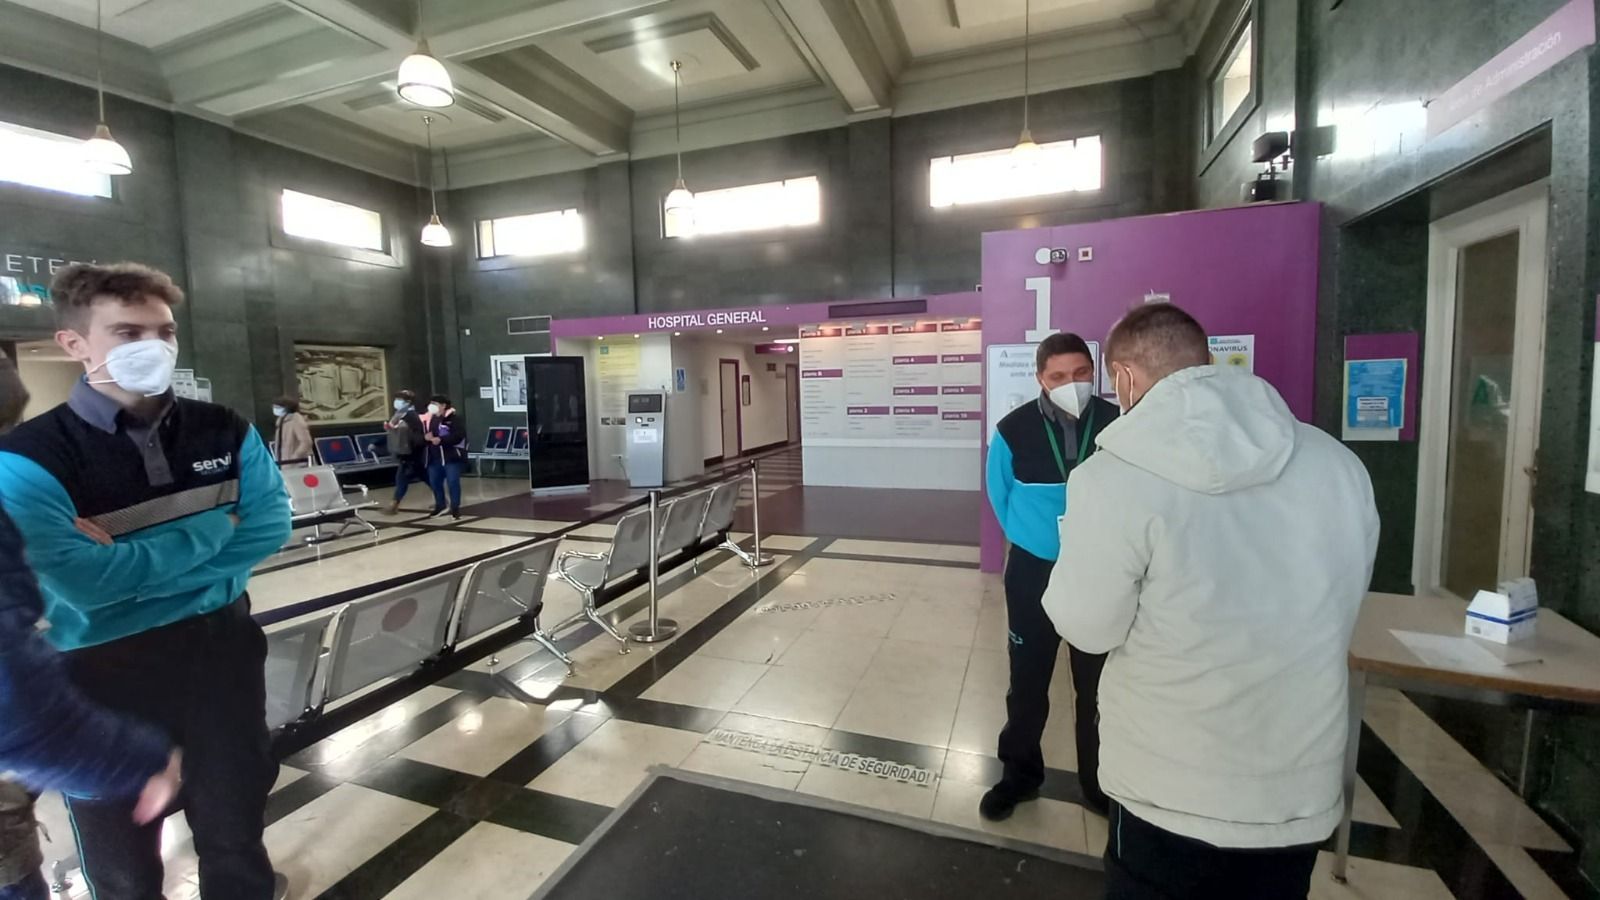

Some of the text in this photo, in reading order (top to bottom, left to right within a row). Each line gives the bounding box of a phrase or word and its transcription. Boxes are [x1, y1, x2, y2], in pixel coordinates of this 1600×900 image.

[6, 254, 97, 276] ETE
[648, 310, 766, 329] HOSPITAL GENERAL
[192, 451, 232, 471] servi
[841, 756, 858, 769] DE
[858, 759, 930, 784] SEGURIDAD!
